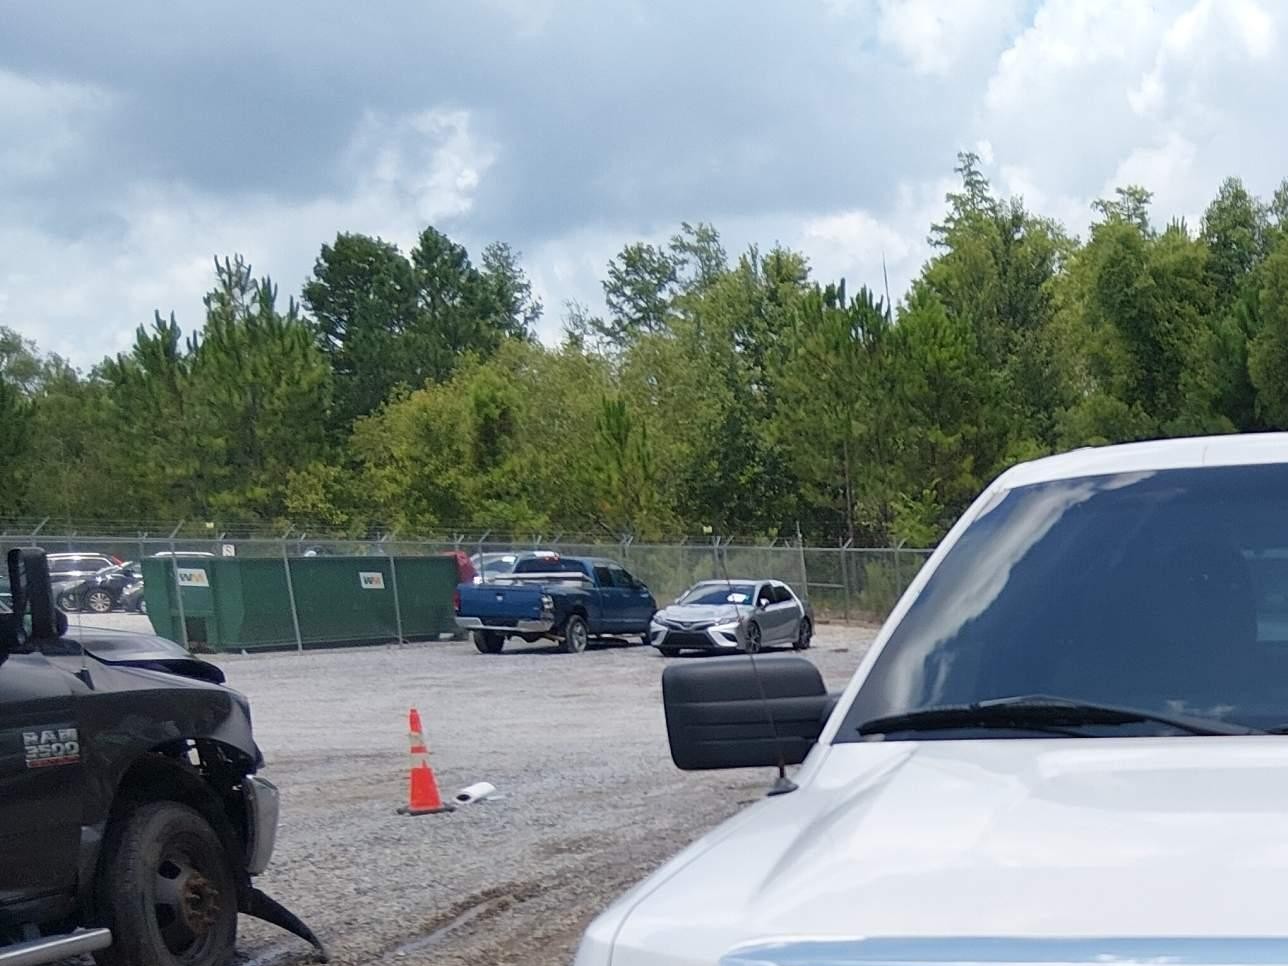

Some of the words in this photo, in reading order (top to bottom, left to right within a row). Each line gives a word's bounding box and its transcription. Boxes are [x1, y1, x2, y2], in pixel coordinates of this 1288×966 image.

[179, 572, 206, 583] WM
[363, 576, 381, 585] WM
[22, 728, 77, 745] RAM
[25, 742, 79, 758] 3500
